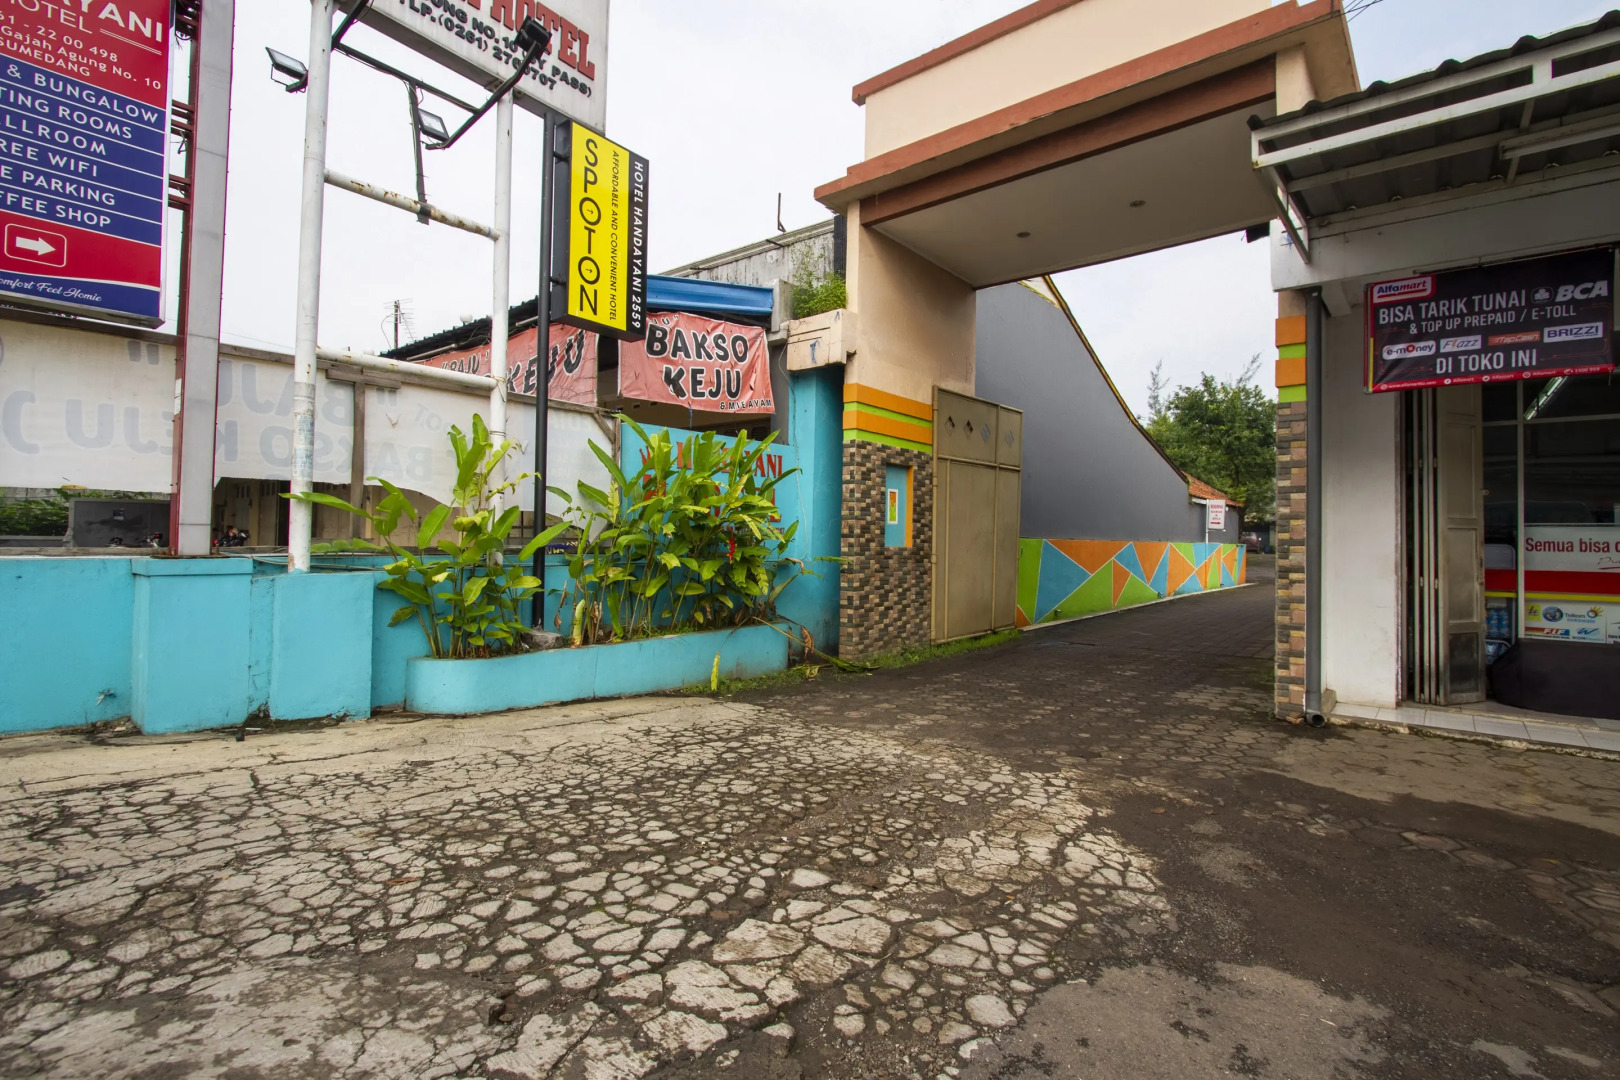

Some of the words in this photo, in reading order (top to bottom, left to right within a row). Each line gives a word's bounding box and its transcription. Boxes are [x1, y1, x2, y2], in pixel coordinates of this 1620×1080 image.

[10, 0, 92, 34] OTEL
[61, 0, 163, 43] YANI
[1, 25, 52, 51] Gajah
[57, 46, 107, 73] Agung
[112, 65, 137, 82] No.
[144, 78, 162, 90] 10
[36, 25, 57, 40] 22
[62, 35, 83, 49] 00
[89, 46, 118, 62] 498
[6, 63, 22, 79] &
[34, 72, 159, 124] BUNGALOW
[551, 65, 592, 98] PASS)
[0, 114, 106, 156] LLROOM
[58, 105, 133, 139] ROOMS
[48, 152, 98, 177] WIFI
[611, 150, 620, 209] AFFORDABLE
[633, 161, 644, 202] HOTEL
[22, 171, 116, 206] PARKING
[55, 205, 111, 227] SHOP
[611, 214, 619, 230] AND
[609, 231, 619, 293] CONVENIENT
[632, 207, 643, 293] HANDAYANI
[1376, 280, 1427, 295] Alfamart
[1379, 305, 1415, 325] BISA
[1419, 297, 1468, 319] TARIK
[1472, 289, 1526, 312] TUNAI
[1555, 280, 1608, 303] BCA
[609, 293, 618, 321] HOTEL
[631, 296, 642, 329] 2559
[1409, 322, 1418, 335] &
[1420, 320, 1443, 334] TOP
[1445, 318, 1461, 330] UP
[1464, 310, 1516, 328] PREPAID
[1531, 304, 1577, 320] E-TOLL
[645, 322, 750, 365] BAKSO
[1547, 325, 1599, 338] BRIZZI
[1436, 357, 1452, 374] DI
[1458, 351, 1504, 372] TOKO
[1511, 348, 1537, 368] INI
[663, 364, 742, 400] KEJU
[719, 401, 726, 410] &
[748, 399, 773, 409] AYAM
[1525, 537, 1574, 552] Semua
[1579, 538, 1610, 553] bisa
